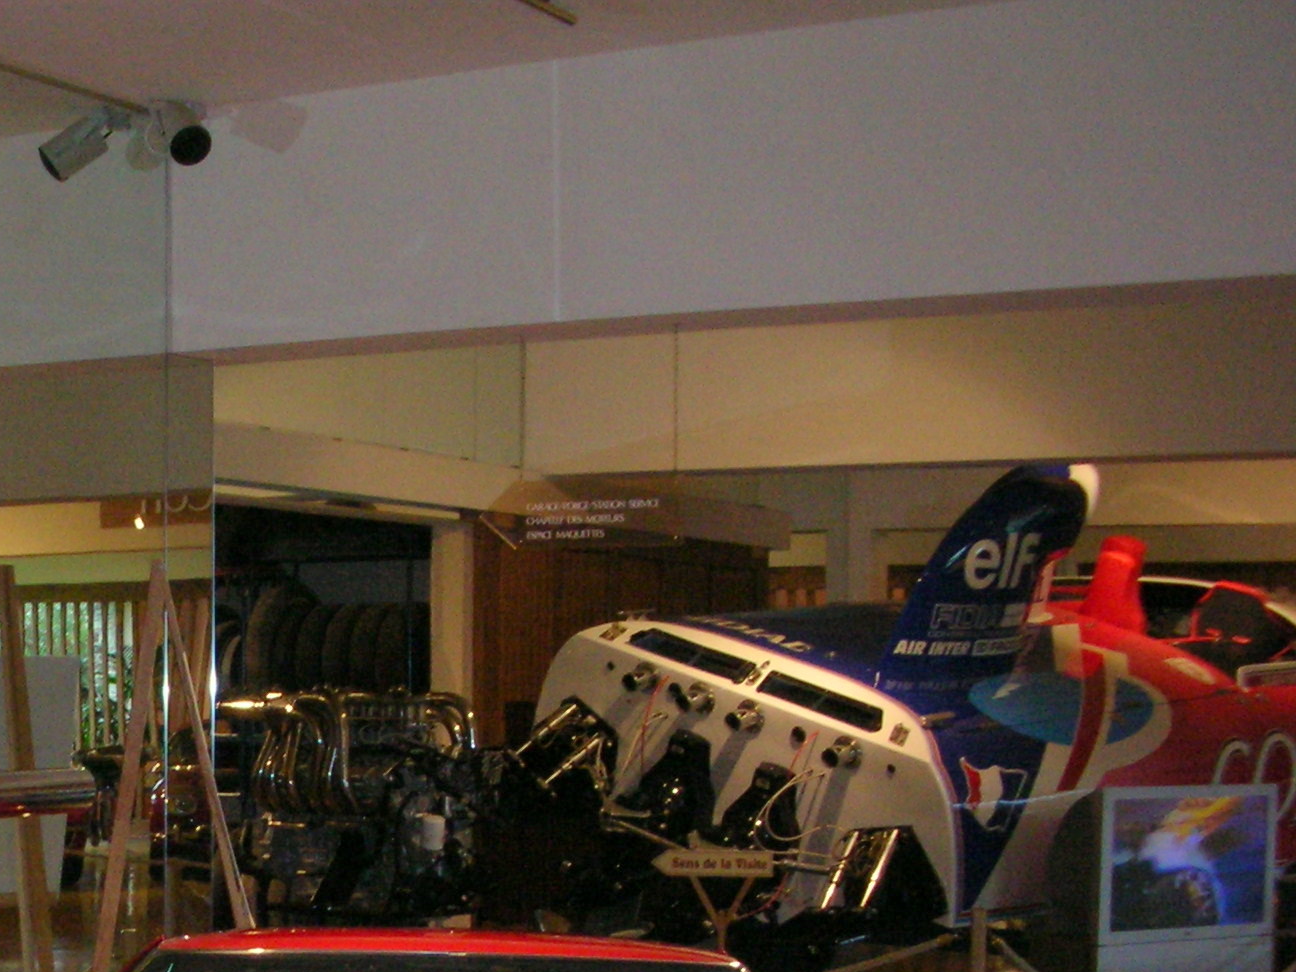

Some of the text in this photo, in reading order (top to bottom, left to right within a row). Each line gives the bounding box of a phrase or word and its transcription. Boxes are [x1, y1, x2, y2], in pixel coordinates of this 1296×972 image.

[586, 513, 625, 523] MOTEURS
[526, 529, 605, 539] ESPACE MAQUETTES
[964, 533, 1042, 590] elf
[893, 639, 927, 655] AIR
[928, 640, 971, 655] INTER
[671, 857, 767, 870] Sens de la Visite
